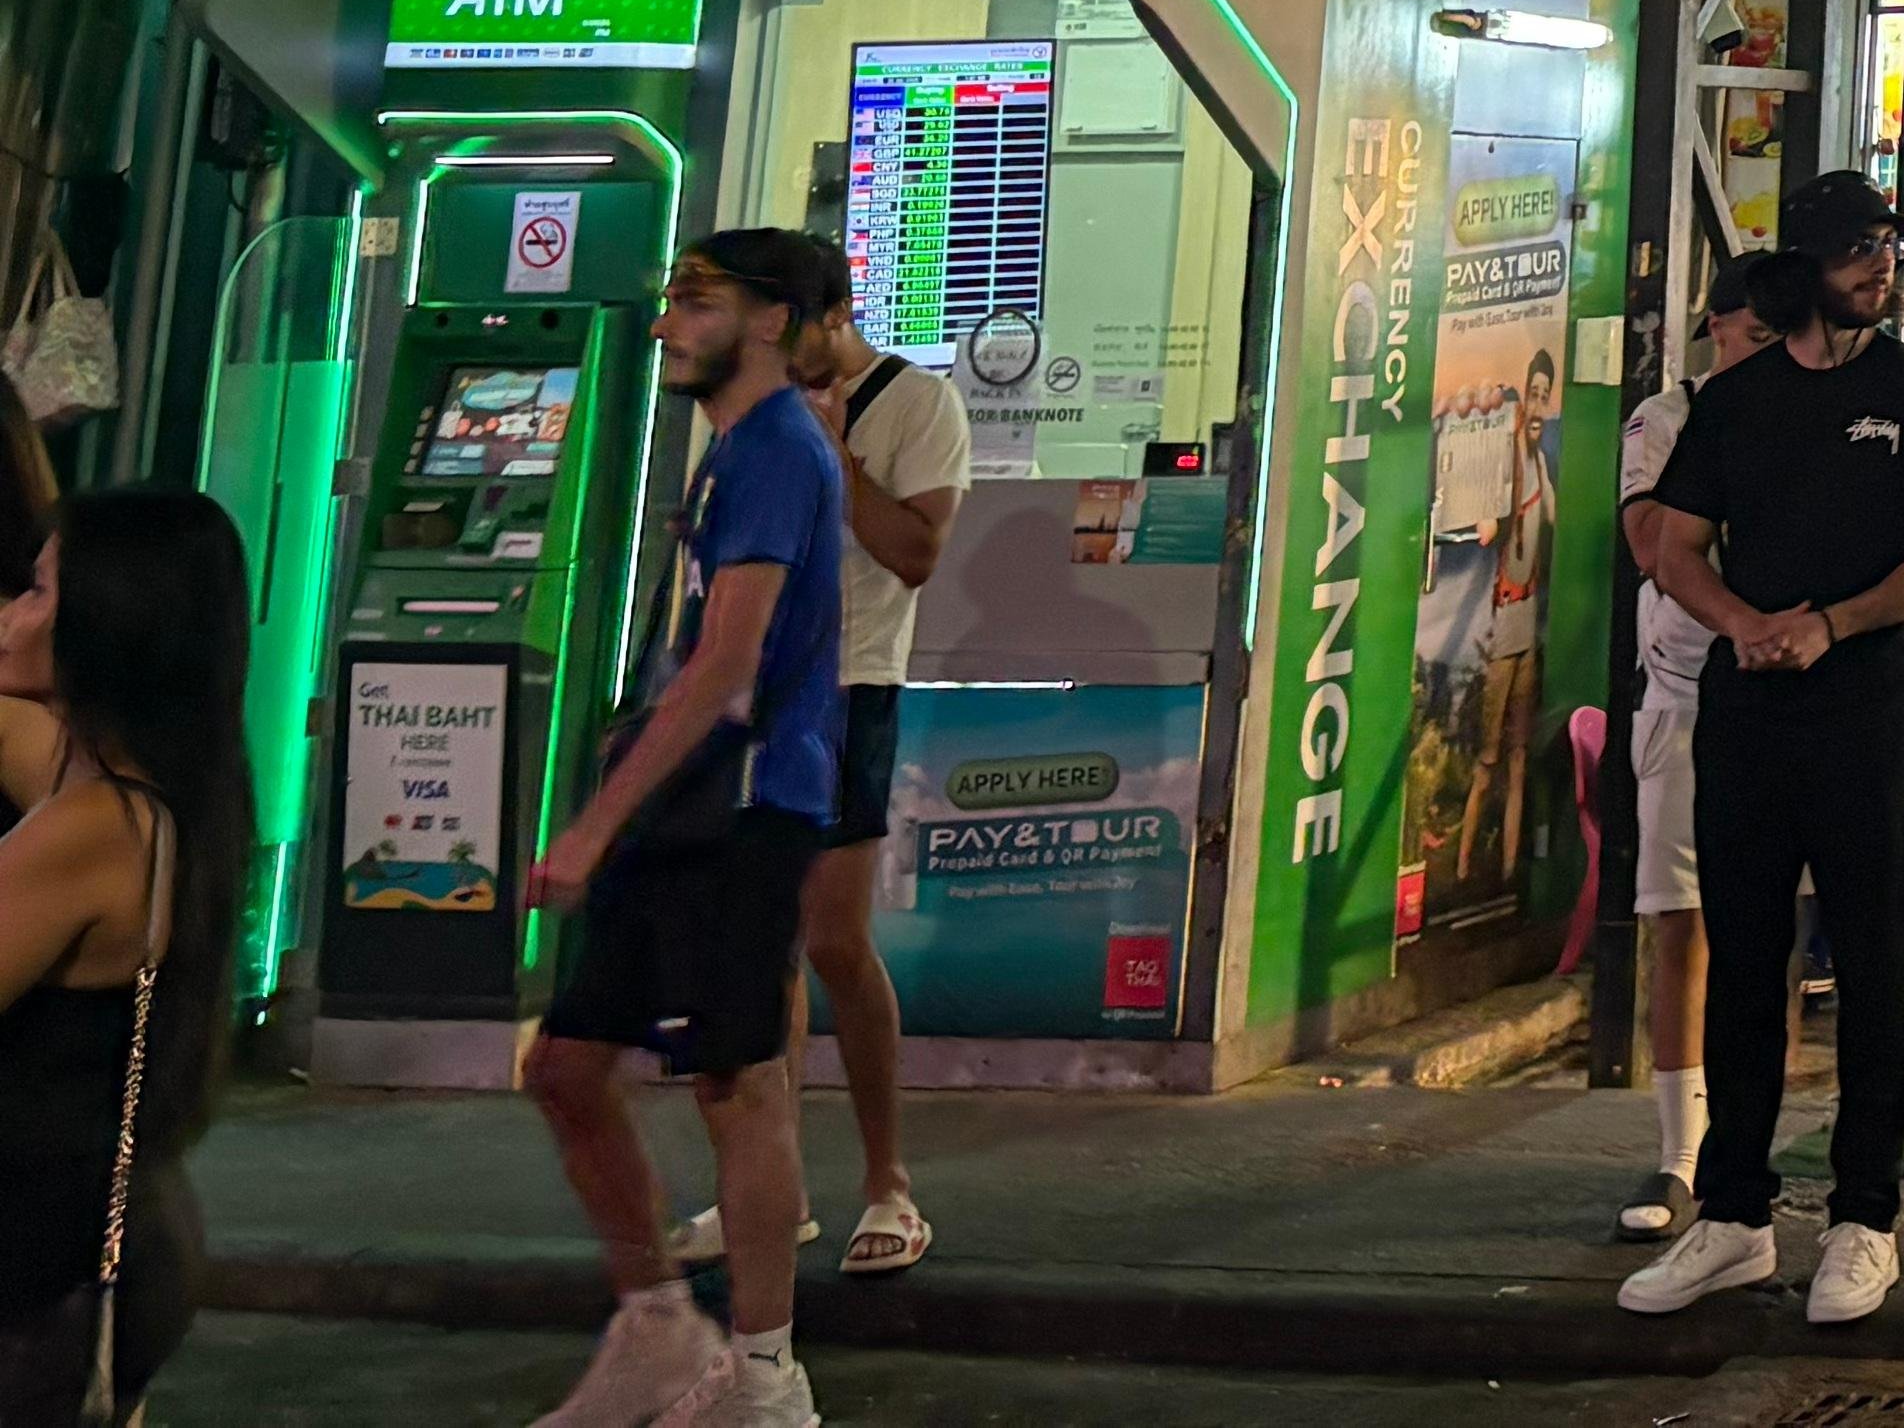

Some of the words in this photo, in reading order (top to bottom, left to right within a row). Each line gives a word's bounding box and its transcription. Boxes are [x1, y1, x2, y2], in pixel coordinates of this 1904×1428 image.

[873, 148, 900, 158] GBP
[872, 161, 899, 172] CNY
[872, 175, 898, 185] AUD
[1459, 197, 1507, 227] APPLY
[1511, 189, 1555, 218] HERE!
[867, 269, 892, 279] CAD
[1382, 120, 1423, 422] CURRENCY
[866, 282, 890, 293] AED
[999, 407, 1085, 423] BANKNOTE
[1292, 118, 1392, 864] EXCHANGE
[358, 704, 419, 728] THAI
[424, 704, 497, 728] BAHT
[401, 779, 450, 800] VISA
[956, 770, 1035, 795] APPLY
[928, 853, 994, 871] Prepaid
[999, 850, 1038, 867] Card
[1060, 846, 1084, 864] QR
[1089, 843, 1162, 863] Payment
